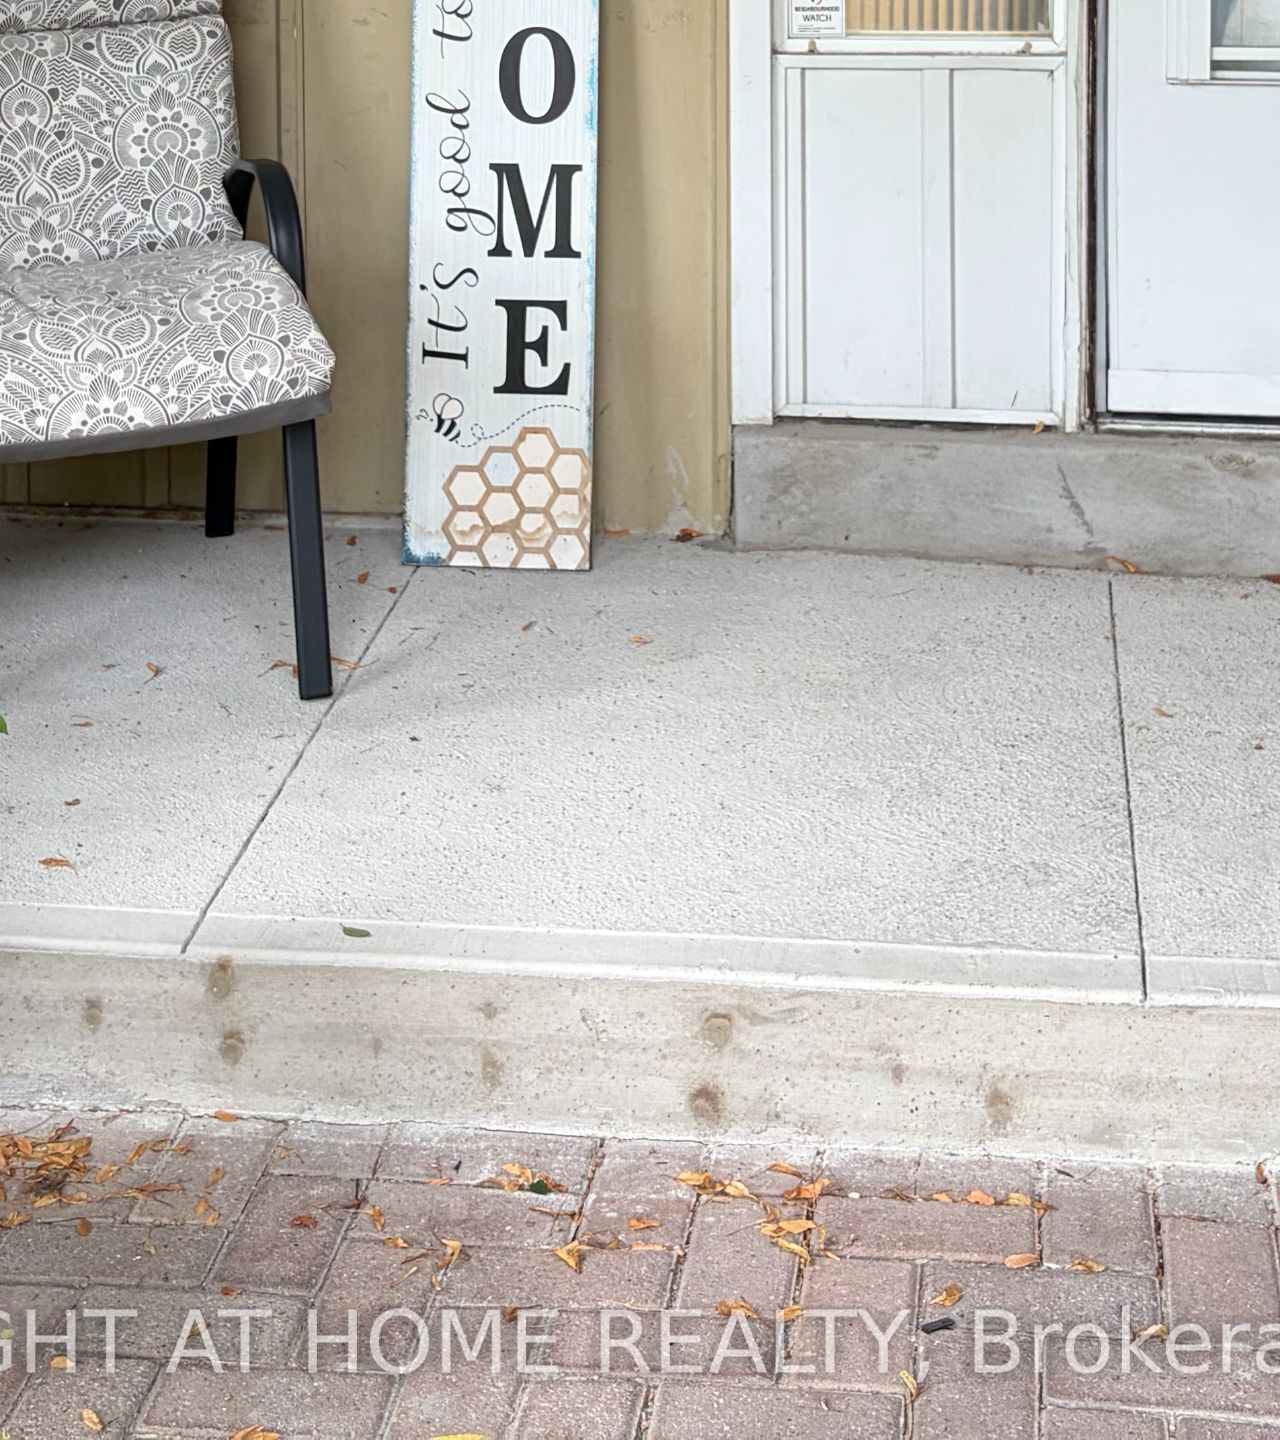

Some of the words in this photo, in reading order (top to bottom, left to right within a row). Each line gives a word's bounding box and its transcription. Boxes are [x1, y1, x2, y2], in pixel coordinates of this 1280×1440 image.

[802, 14, 832, 22] WATCH
[425, 89, 496, 236] good
[420, 263, 480, 370] It's
